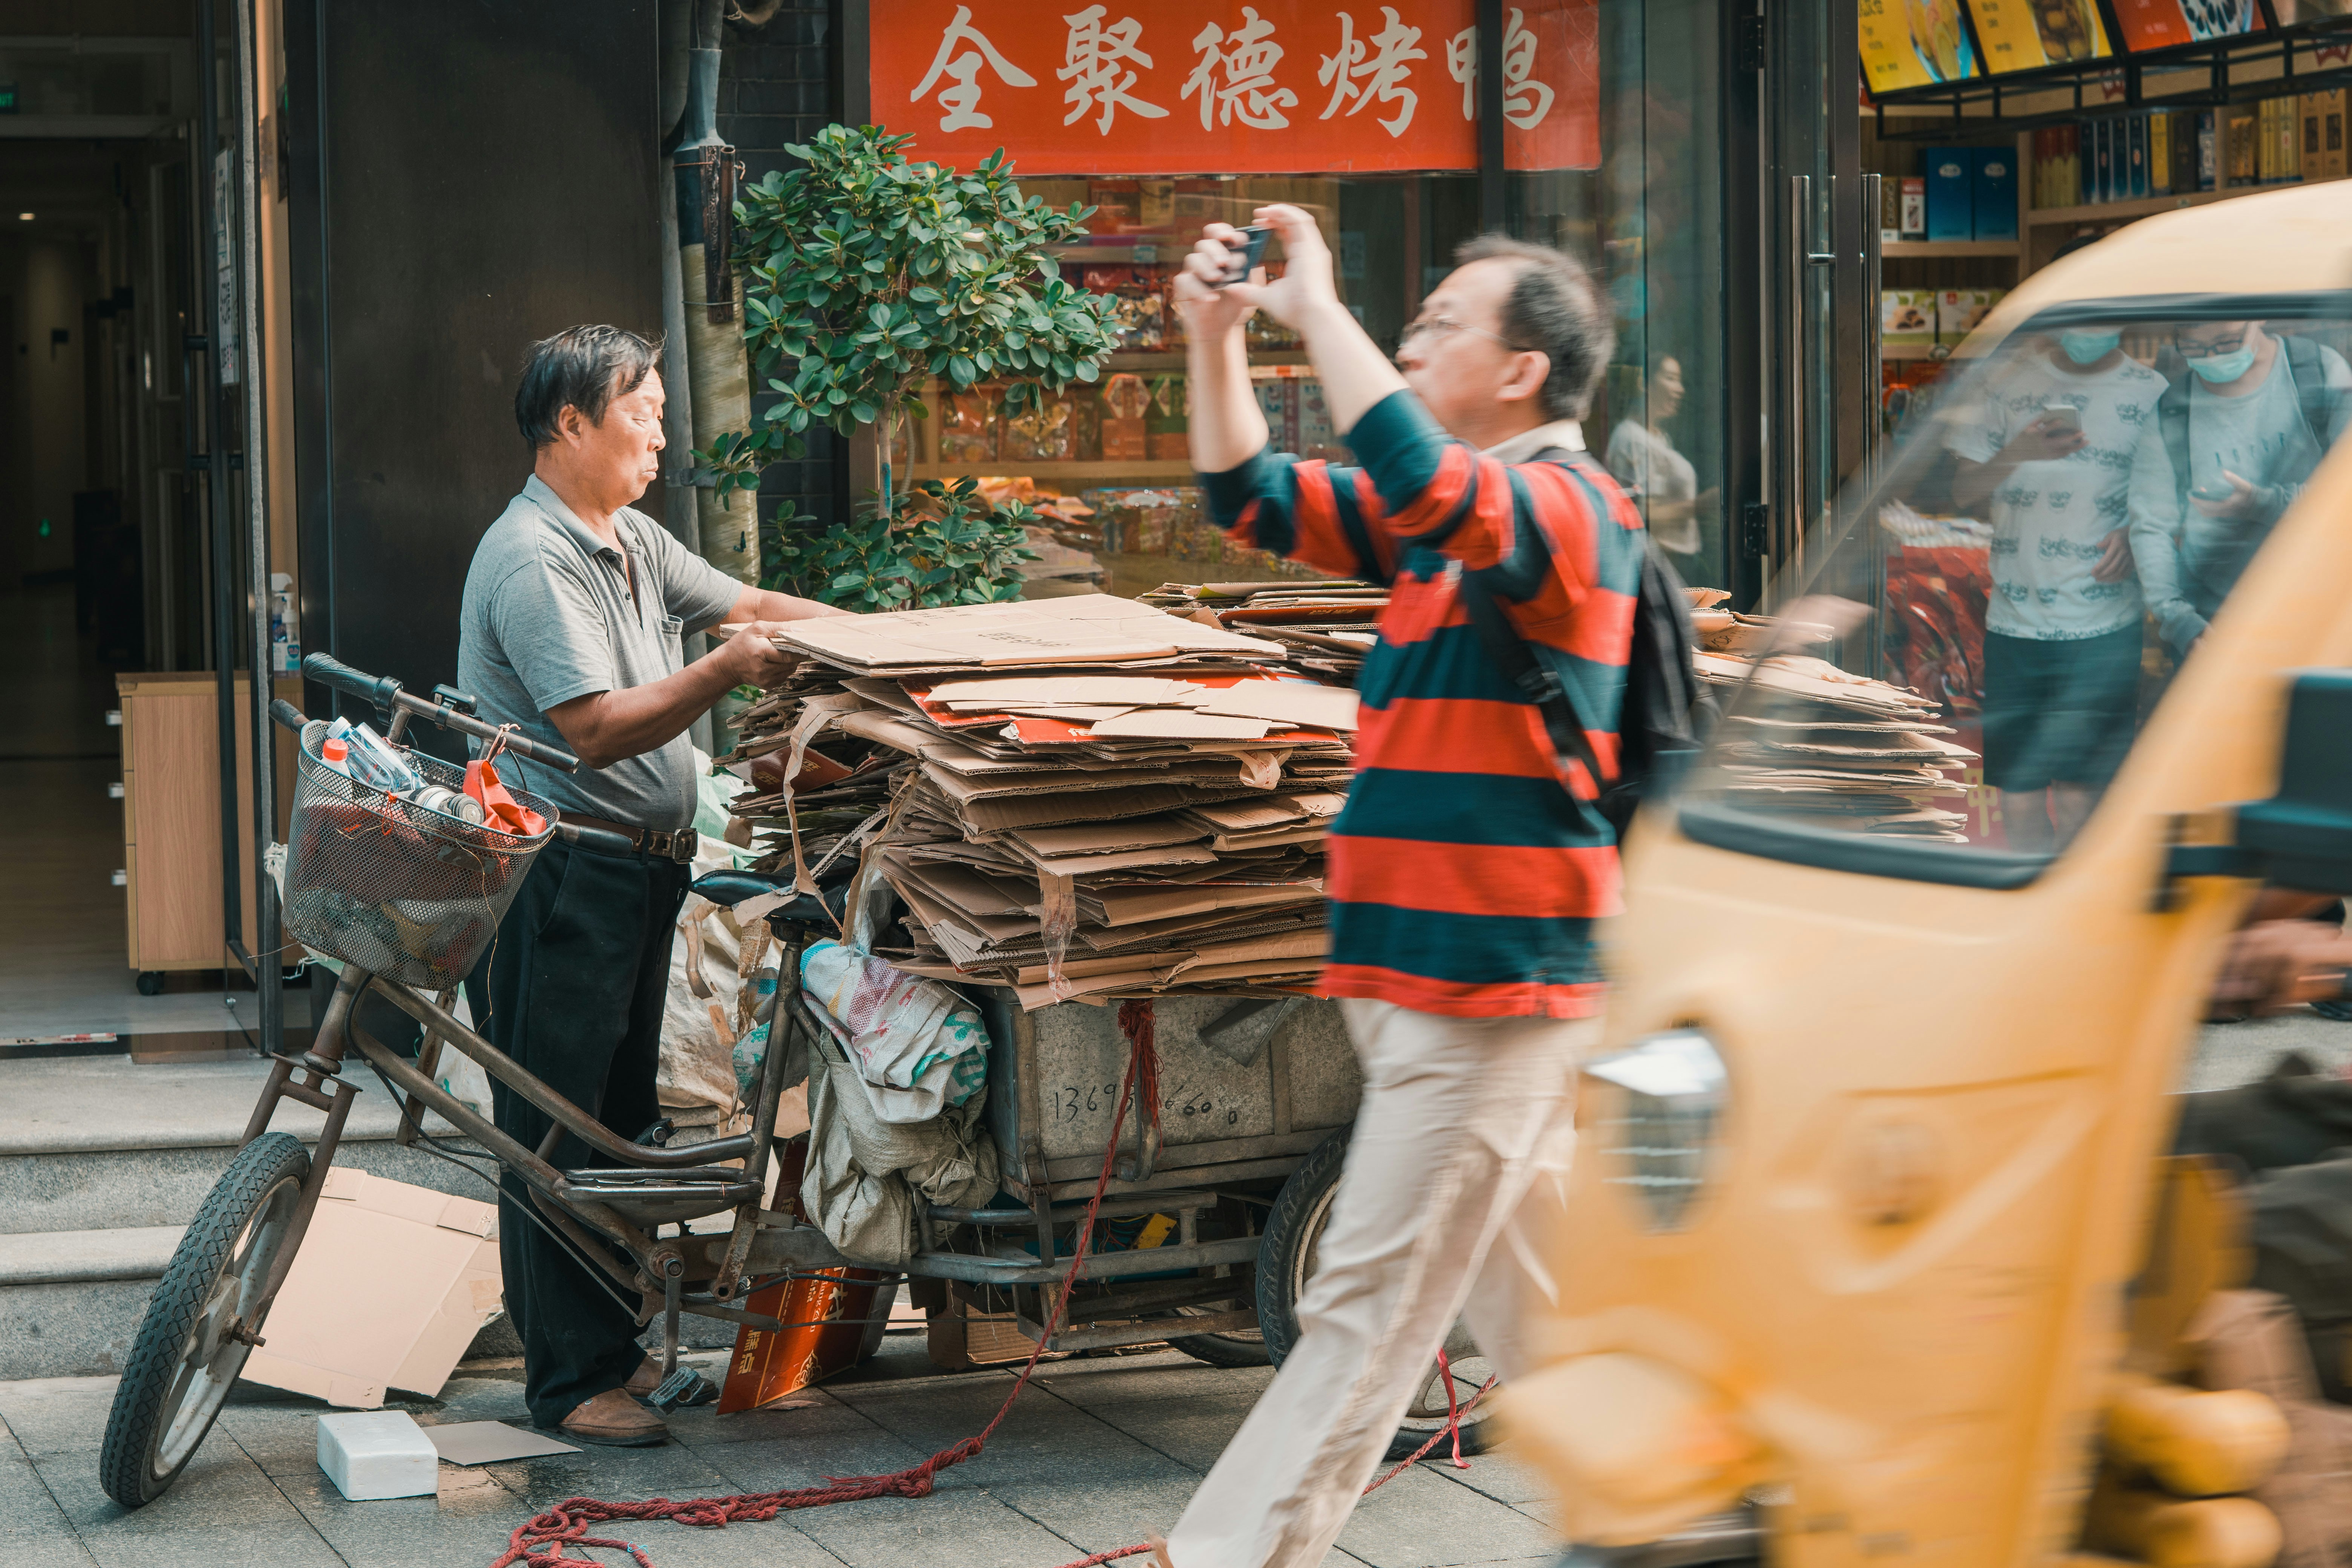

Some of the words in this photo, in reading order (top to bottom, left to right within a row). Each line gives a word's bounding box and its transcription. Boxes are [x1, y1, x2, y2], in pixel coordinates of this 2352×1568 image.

[910, 5, 1555, 138] 全聚德烤鸭
